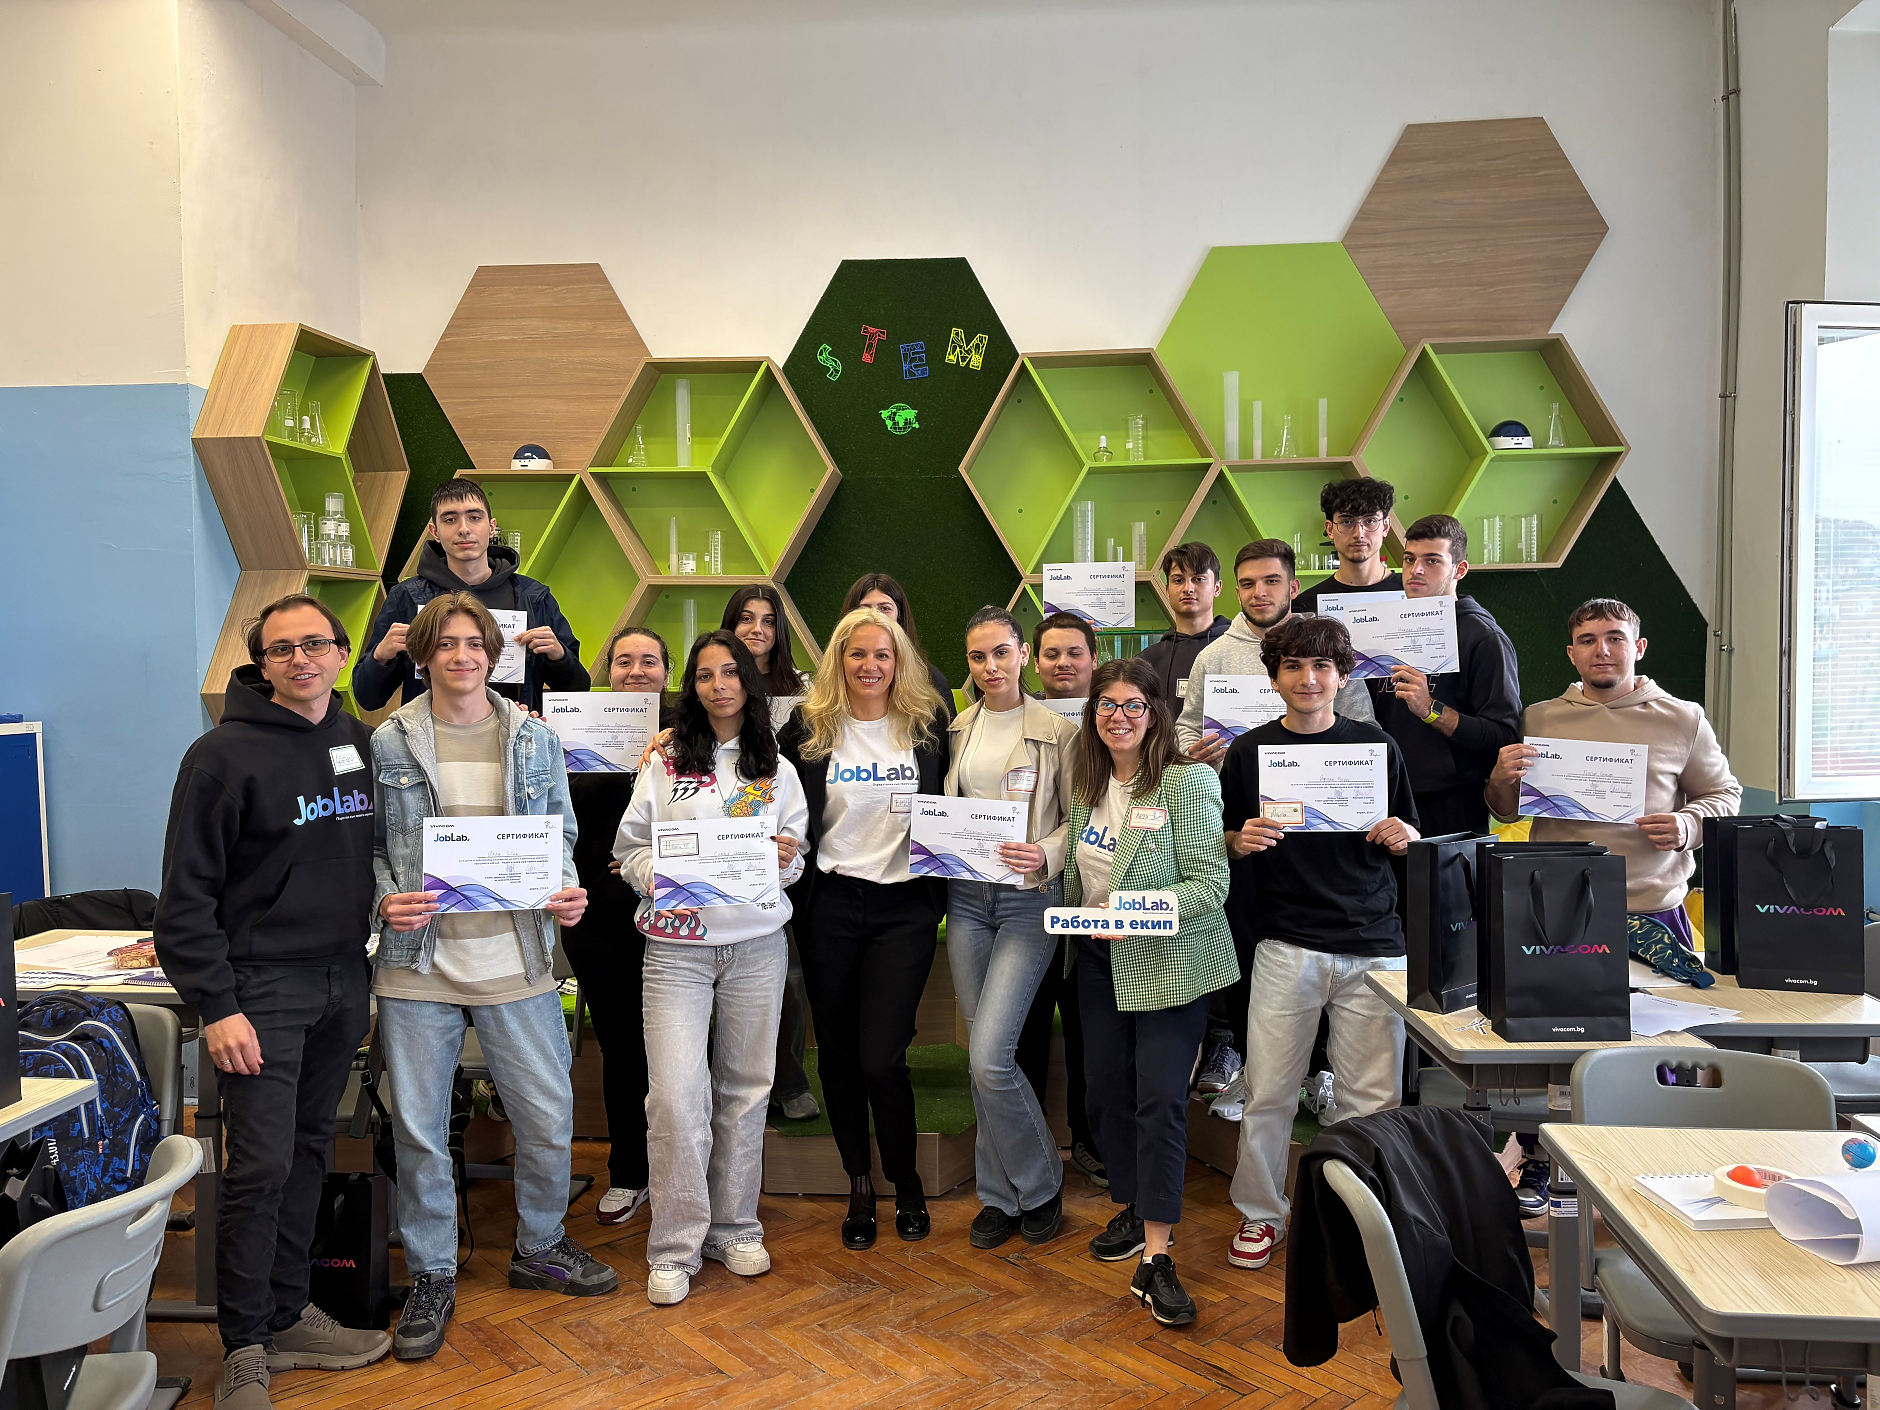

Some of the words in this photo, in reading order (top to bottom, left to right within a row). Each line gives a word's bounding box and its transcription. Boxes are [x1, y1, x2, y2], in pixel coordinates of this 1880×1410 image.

[817, 325, 988, 381] STEM
[1399, 610, 1444, 619] СЕРТИФИКАТ
[1324, 759, 1374, 767] СЕРТИФИКАТ
[1585, 755, 1634, 765] СЕРТИФИКАТ
[970, 813, 1016, 823] СЕРТИФИКАТ
[496, 832, 550, 840] СЕРТИФИКАТ
[716, 832, 765, 841] СЕРТИФИКАТ
[1755, 904, 1846, 916] VIVACOM
[1050, 915, 1110, 930] Работа
[1114, 919, 1125, 930] в
[1129, 919, 1173, 930] екип
[1521, 944, 1611, 955] VIVACOM
[1784, 977, 1818, 986] vivacom.bg
[310, 1258, 356, 1268] ACOM
